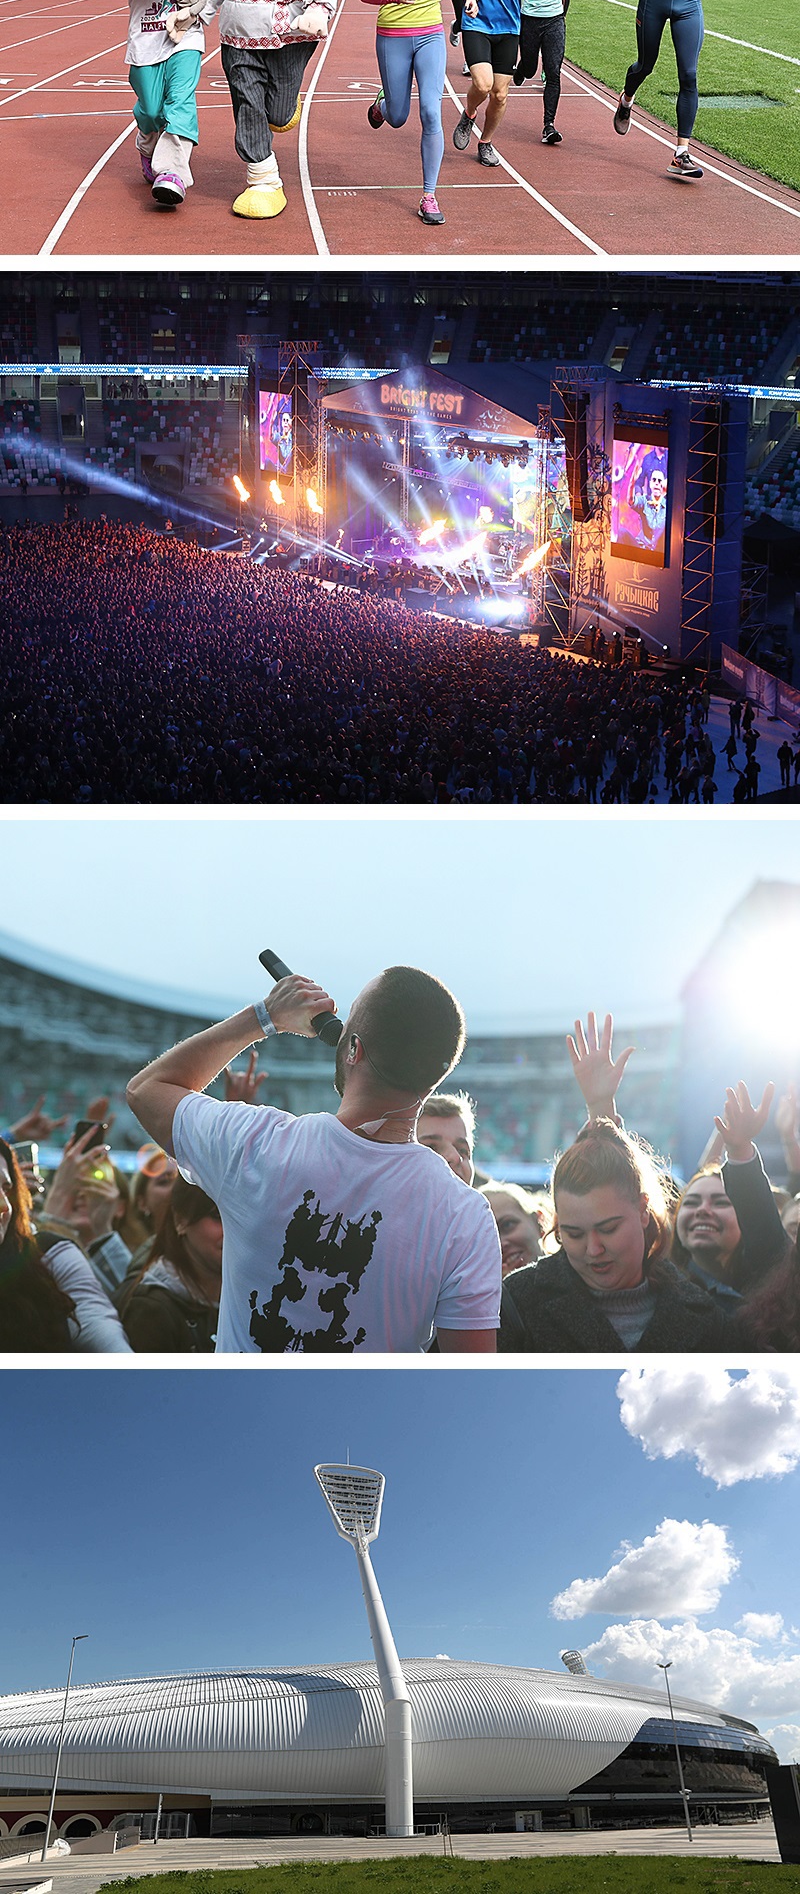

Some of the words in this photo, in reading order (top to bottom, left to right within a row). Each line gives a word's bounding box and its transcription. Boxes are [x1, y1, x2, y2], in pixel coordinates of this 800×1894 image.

[381, 384, 428, 408] BRIGHT
[430, 392, 464, 415] FEST
[614, 580, 659, 613] РЭЧЫЦКАЕ
